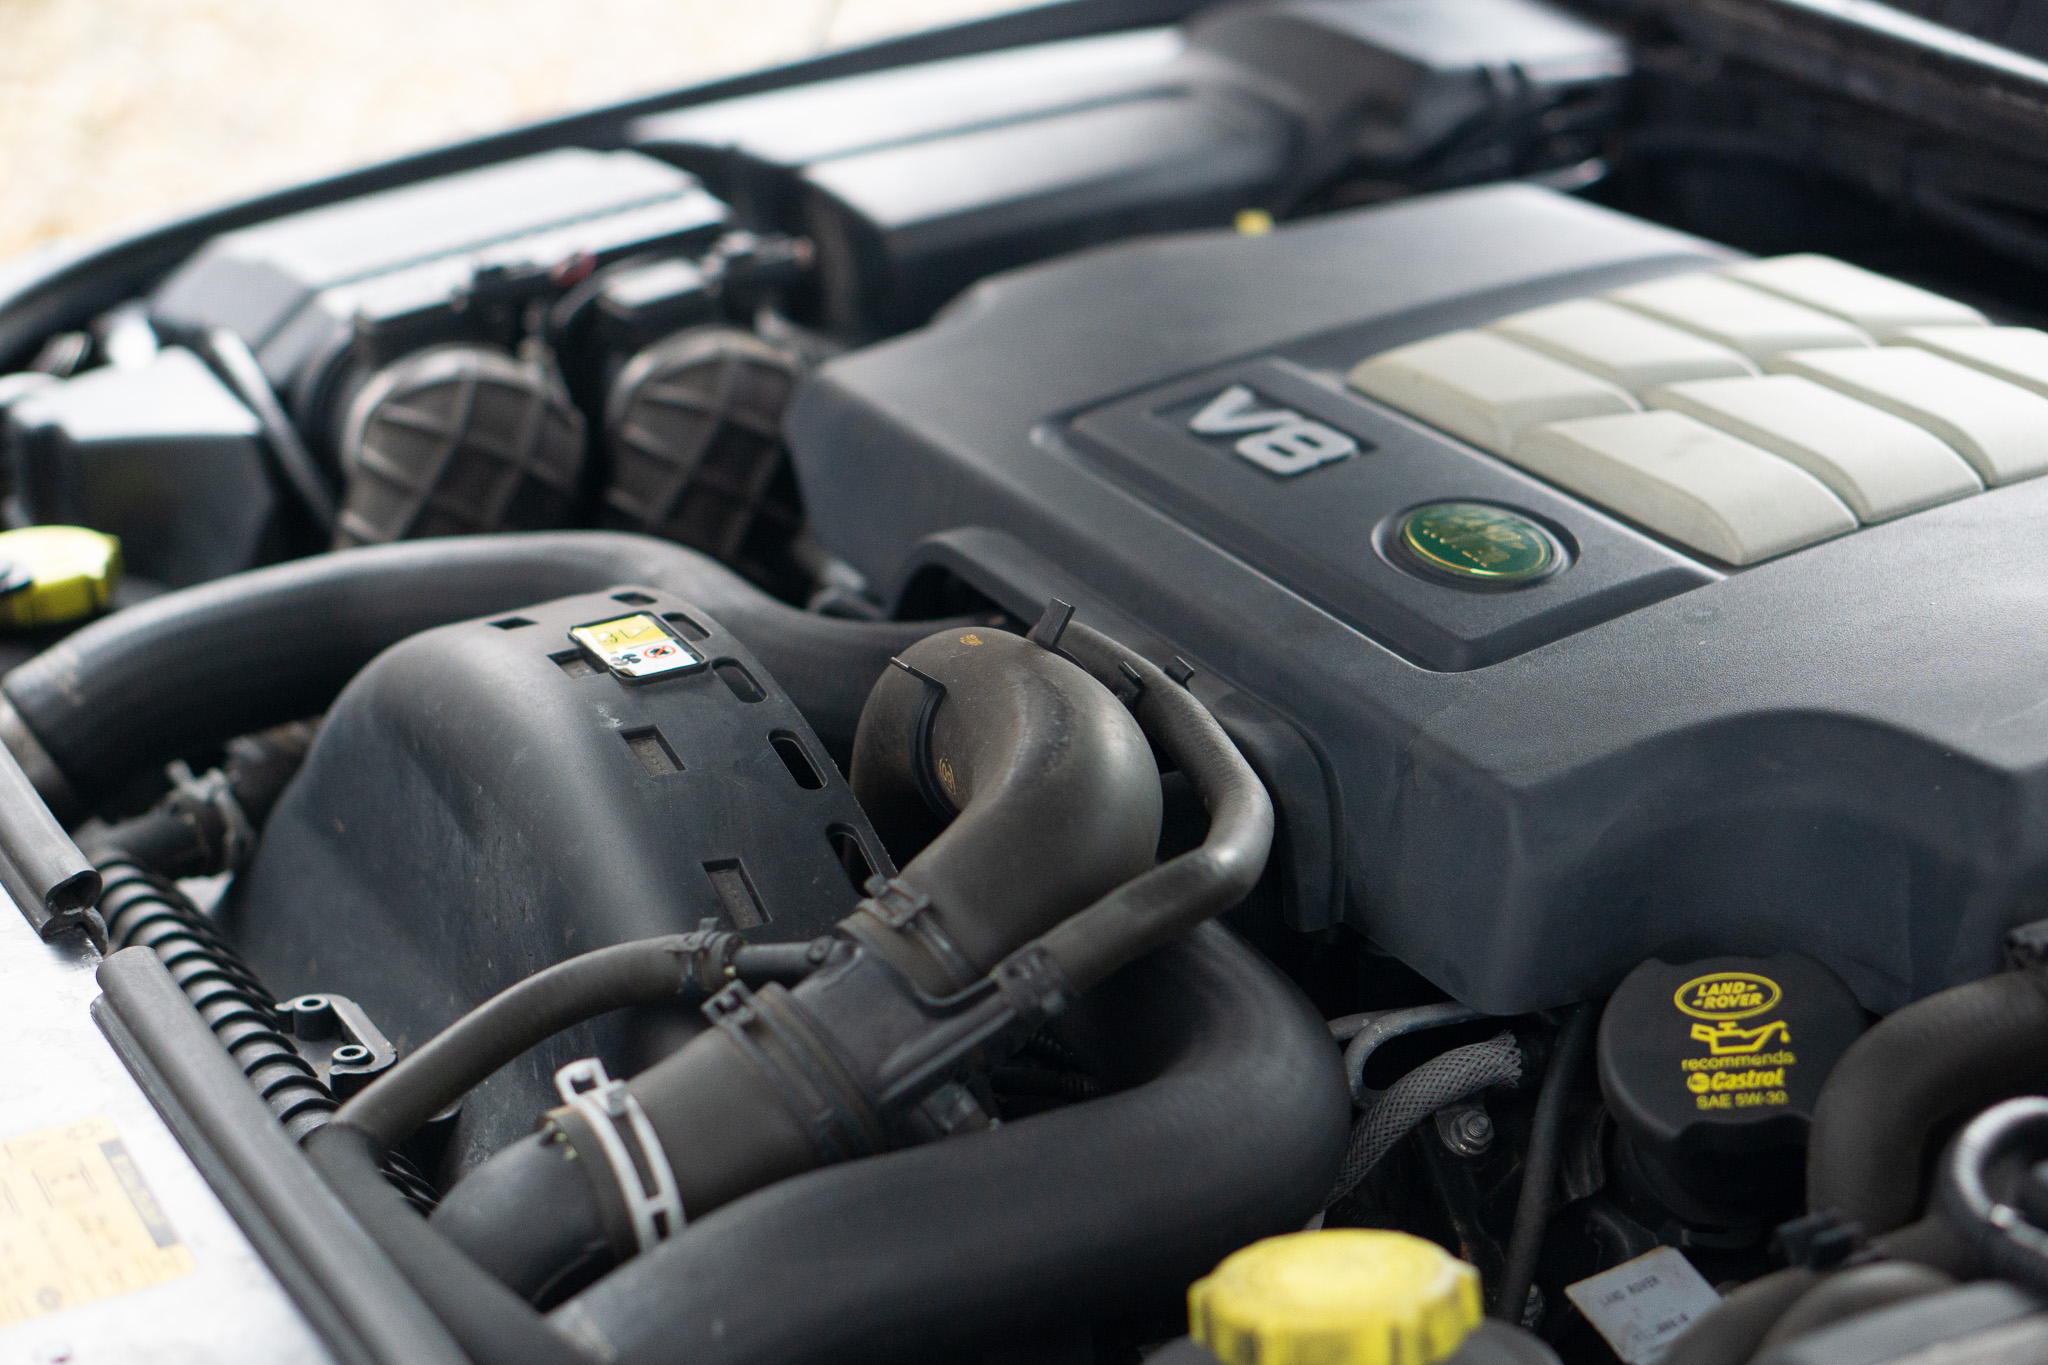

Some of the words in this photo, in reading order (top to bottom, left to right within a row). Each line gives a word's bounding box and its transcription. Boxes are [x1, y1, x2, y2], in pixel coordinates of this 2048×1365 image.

[1190, 385, 1357, 475] V8
[1697, 981, 1747, 997] LAND
[1703, 992, 1764, 1010] ROVER
[1681, 1050, 1797, 1071] recommends
[1710, 1067, 1786, 1092] Castrol
[1696, 1093, 1733, 1110] SAE
[1735, 1090, 1789, 1107] 5W-30
